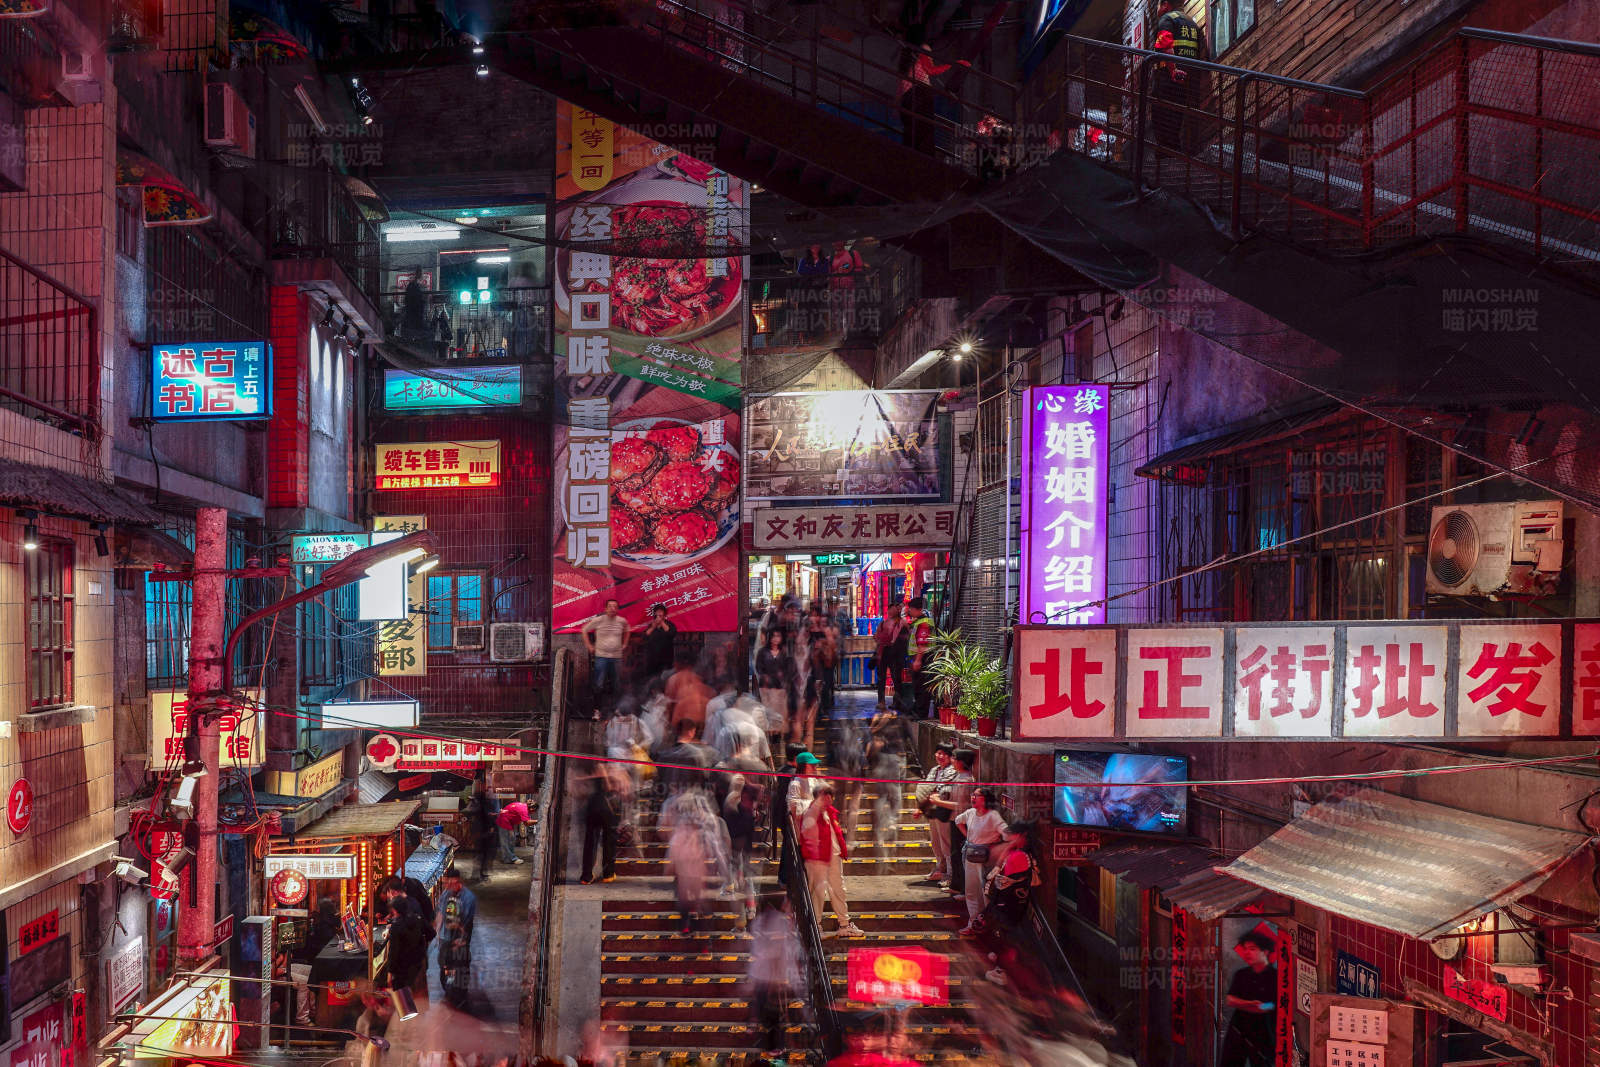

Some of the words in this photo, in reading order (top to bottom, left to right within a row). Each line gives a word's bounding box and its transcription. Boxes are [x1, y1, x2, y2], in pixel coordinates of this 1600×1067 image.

[569, 206, 612, 375] 经典口味
[160, 348, 237, 379] 述古
[645, 342, 715, 372] 绝味双椒
[244, 347, 258, 412] 请上五
[639, 364, 707, 393] 鲜吃为敬
[159, 383, 237, 413] 书店
[1037, 389, 1104, 414] 心缘
[384, 448, 460, 471] 缆车售票
[568, 397, 610, 567] 重磅回归
[304, 535, 331, 543] SALON
[766, 511, 955, 541] 文和友无限公司
[1332, 1047, 1380, 1061] 工作区域
